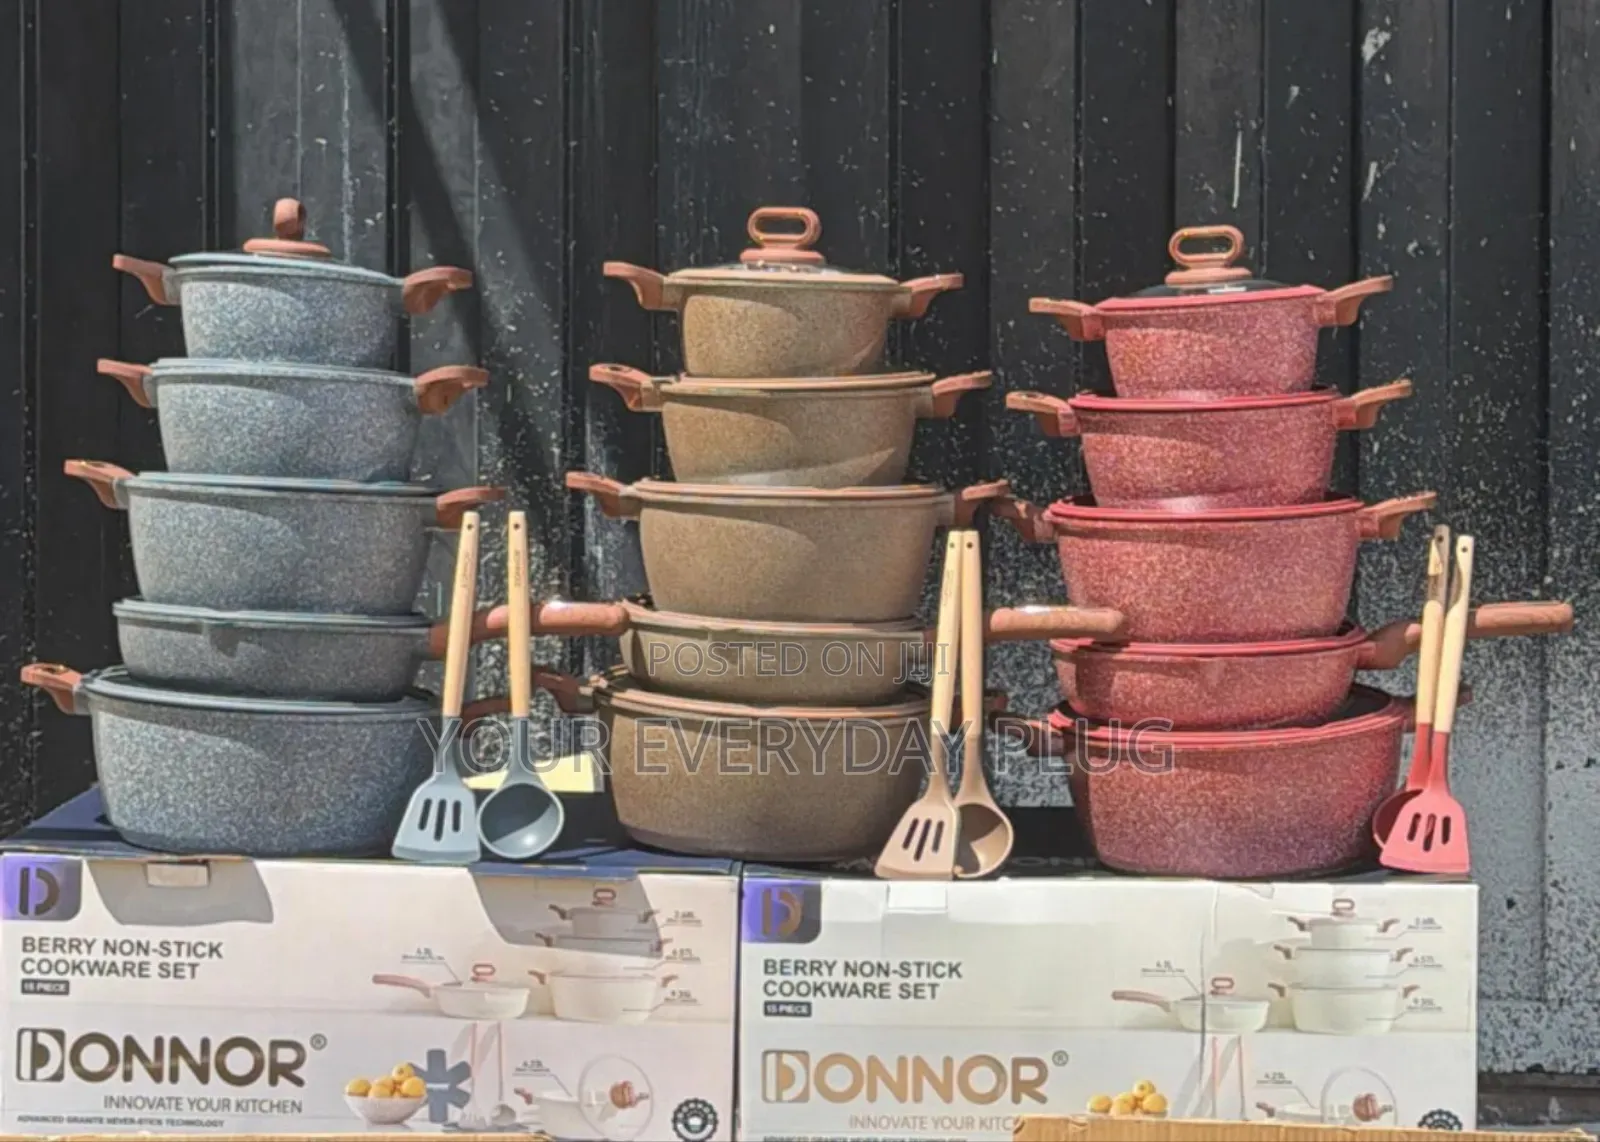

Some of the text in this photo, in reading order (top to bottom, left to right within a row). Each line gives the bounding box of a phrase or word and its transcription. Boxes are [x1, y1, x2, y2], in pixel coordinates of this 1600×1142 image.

[22, 936, 224, 959] BERRY NON-STICK
[21, 957, 200, 980] COOKWARE SET
[763, 959, 963, 980] BERRY NON-STICK
[763, 980, 940, 1001] COOKWARE SET
[780, 1004, 808, 1015] PIECE
[16, 1028, 307, 1088] DONNOR
[761, 1050, 1050, 1106] DONNOR
[104, 1096, 303, 1114] INNOVATE YOUR KITCHEN
[17, 1115, 64, 1124] ADVANCED
[106, 1118, 162, 1127] NEVER-STICK
[165, 1119, 224, 1128] TECHNOLOGY
[850, 1115, 1014, 1132] INNOVATE YOUR KITC
